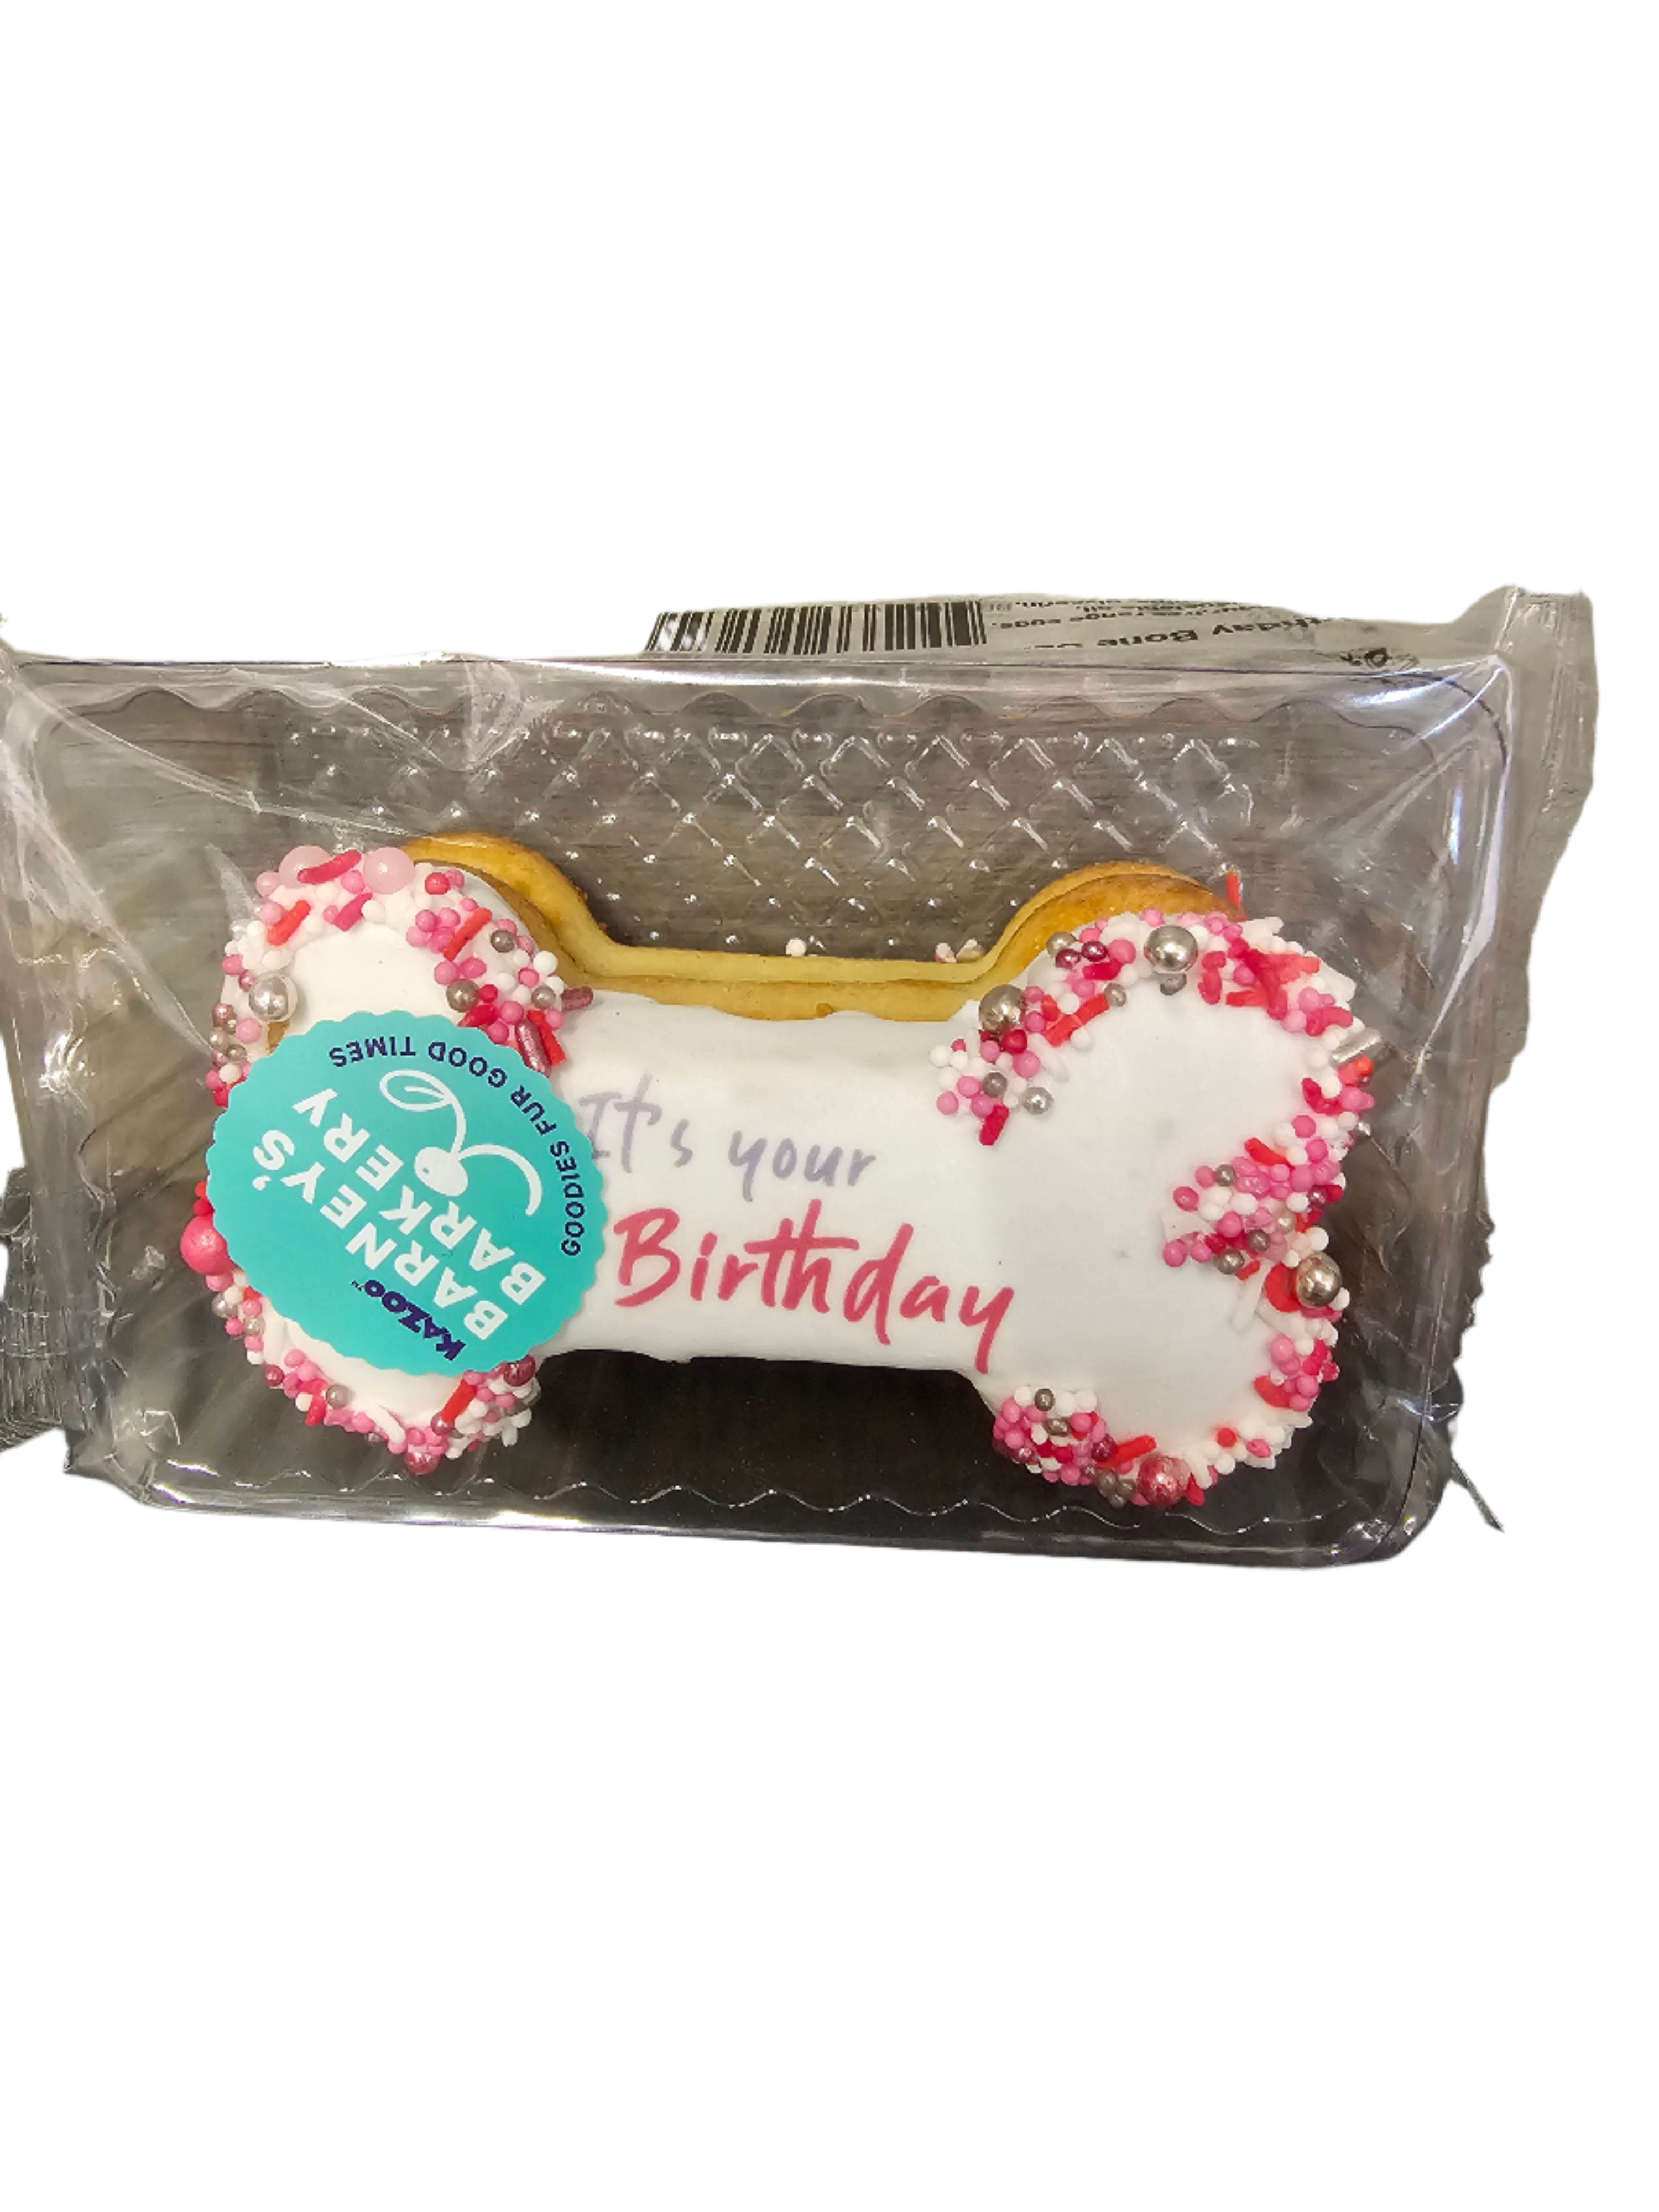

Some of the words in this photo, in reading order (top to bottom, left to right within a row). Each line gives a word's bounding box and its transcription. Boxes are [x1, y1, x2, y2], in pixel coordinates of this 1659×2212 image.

[328, 1036, 416, 1068] TIMES
[427, 1041, 508, 1088] GOOD
[510, 1084, 557, 1136] FUR
[292, 1088, 546, 1305] BARKERY
[550, 1140, 586, 1256] GOODIES
[728, 1130, 876, 1202] your
[252, 1130, 508, 1340] BARNEY'S
[614, 1199, 1014, 1374] Birthday
